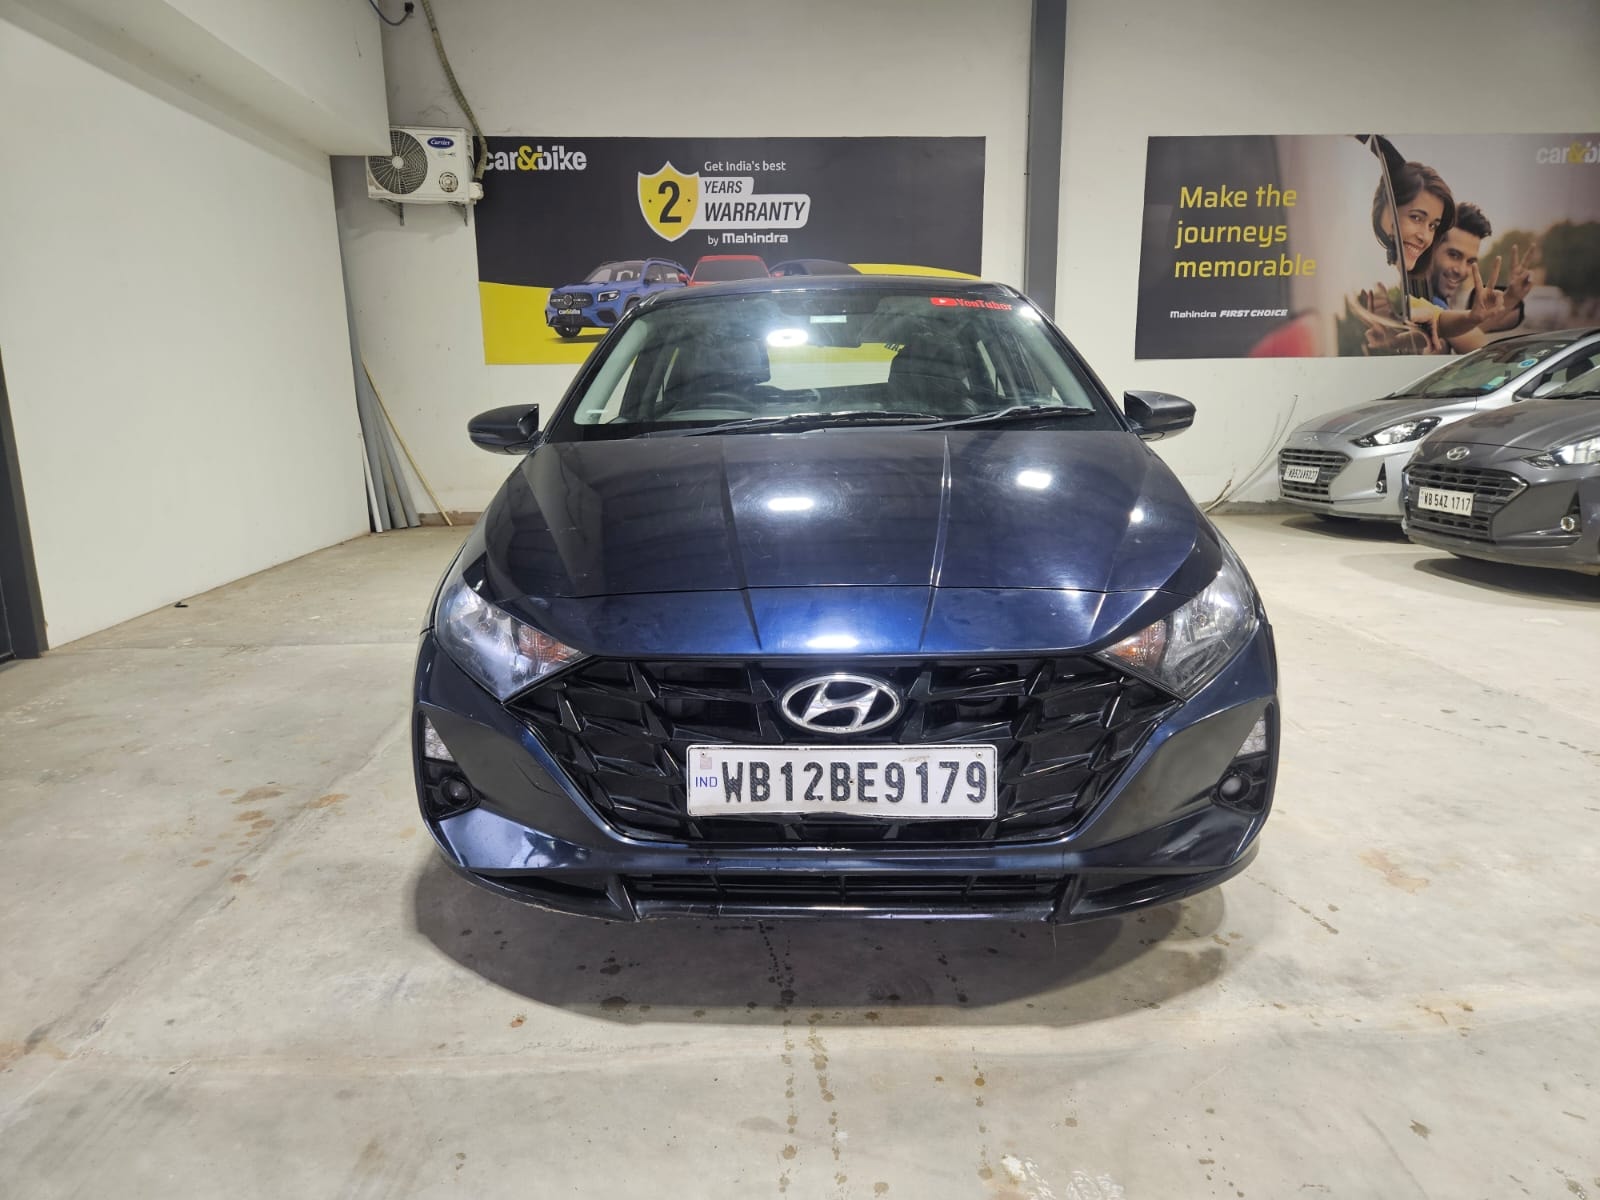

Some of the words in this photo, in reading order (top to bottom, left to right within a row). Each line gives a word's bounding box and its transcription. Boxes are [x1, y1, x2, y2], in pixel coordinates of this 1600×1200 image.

[484, 145, 587, 171] car&bike
[704, 161, 723, 171] Get
[726, 161, 760, 171] India's
[762, 161, 786, 171] best
[704, 181, 742, 194] YEARS
[1179, 184, 1248, 208] Make
[1256, 184, 1297, 207] the
[658, 180, 682, 223] 2
[705, 202, 806, 221] WARRANTY
[708, 235, 719, 246] by
[722, 233, 788, 244] Mahindra
[1174, 220, 1288, 249] journeys
[1174, 253, 1316, 278] memorable
[1170, 309, 1217, 318] Mahindra
[1219, 309, 1250, 318] FIRST
[1250, 309, 1288, 317] CHOICE
[1434, 493, 1448, 508] 54Z
[1452, 496, 1471, 511] 1717
[695, 776, 718, 788] IND
[722, 761, 987, 803] WB12BE9179
